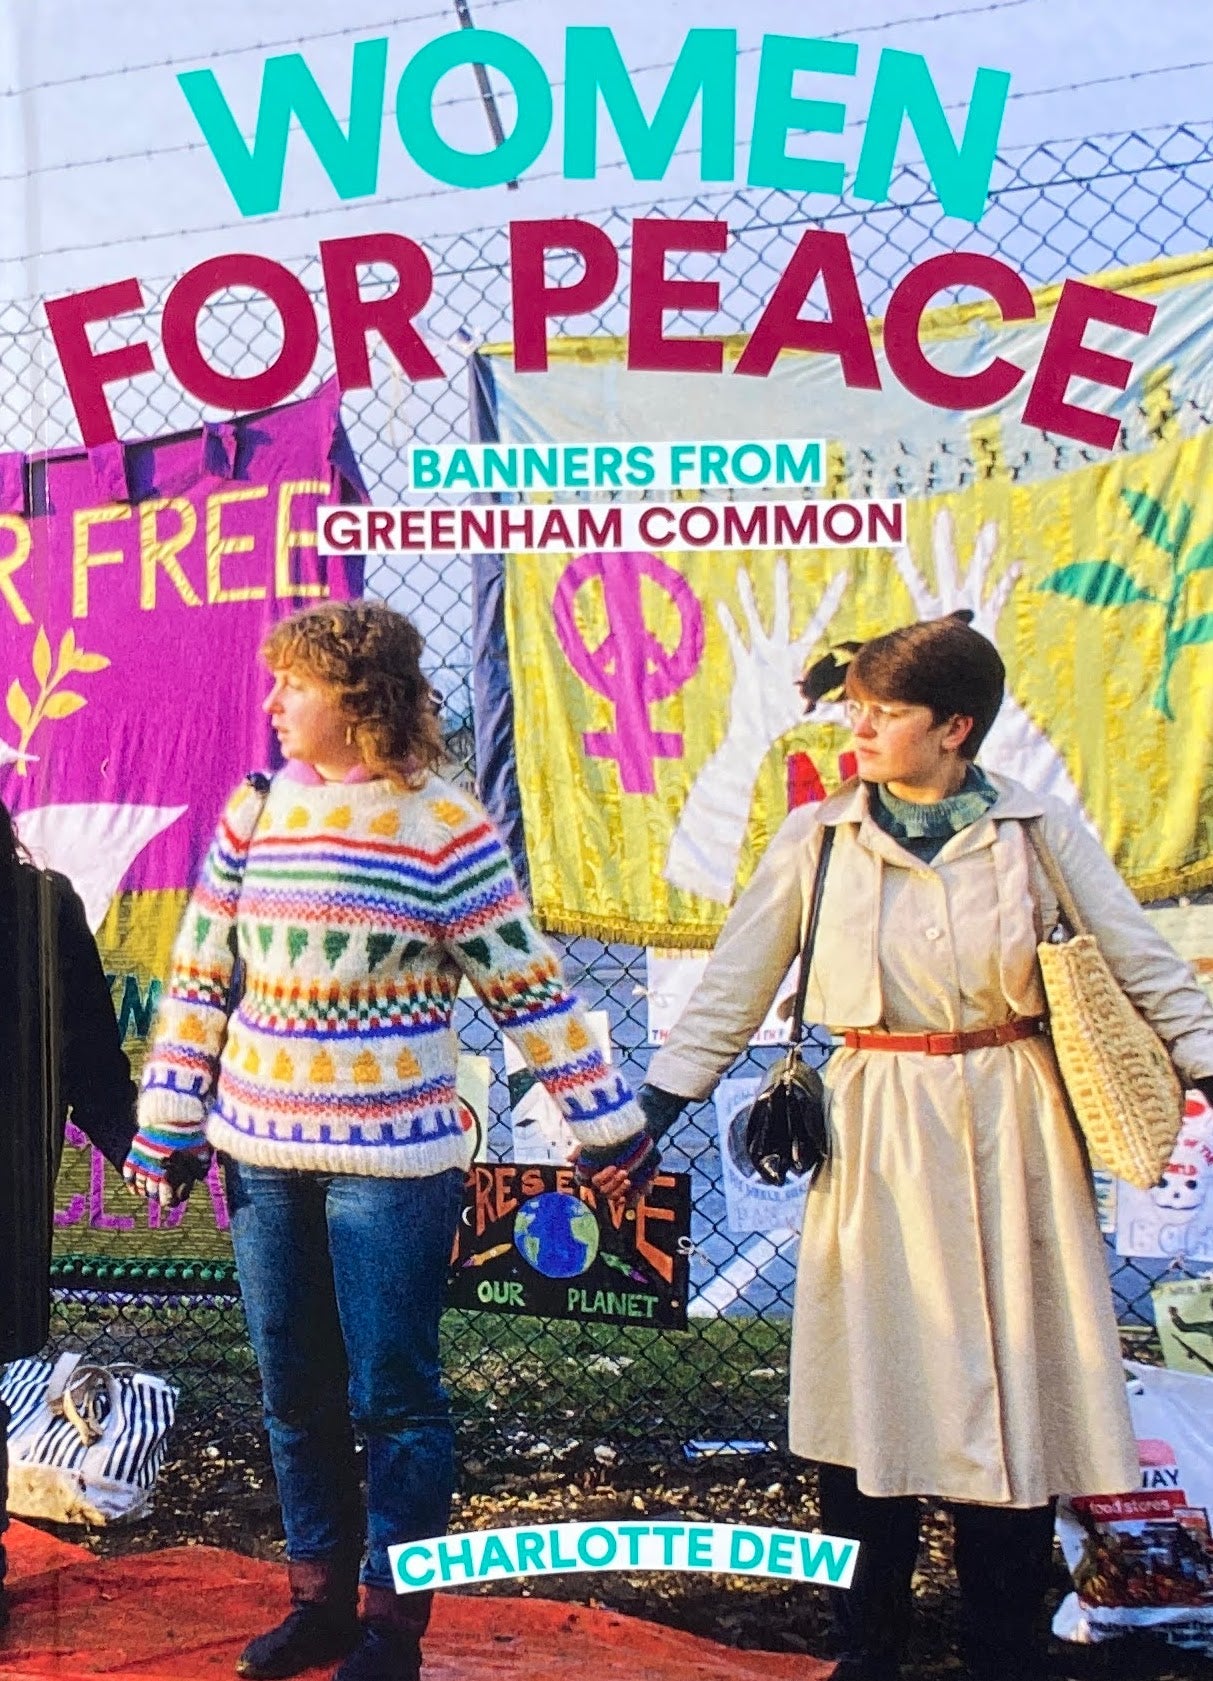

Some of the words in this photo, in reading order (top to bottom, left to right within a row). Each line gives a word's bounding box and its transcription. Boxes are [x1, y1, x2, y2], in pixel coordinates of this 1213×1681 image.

[177, 26, 1010, 222] WOMEN
[45, 234, 443, 445] FOR
[511, 219, 1156, 449] PEACE
[412, 446, 654, 489] BANNERS
[671, 443, 820, 485] FROM
[72, 480, 330, 619] FREE
[325, 510, 620, 549] GREENHAM
[640, 504, 901, 545] COMMON
[477, 1280, 525, 1306] OUR
[568, 1288, 659, 1318] PLANET
[397, 1527, 714, 1587] CHARLOTTE
[730, 1530, 855, 1582] DEW
